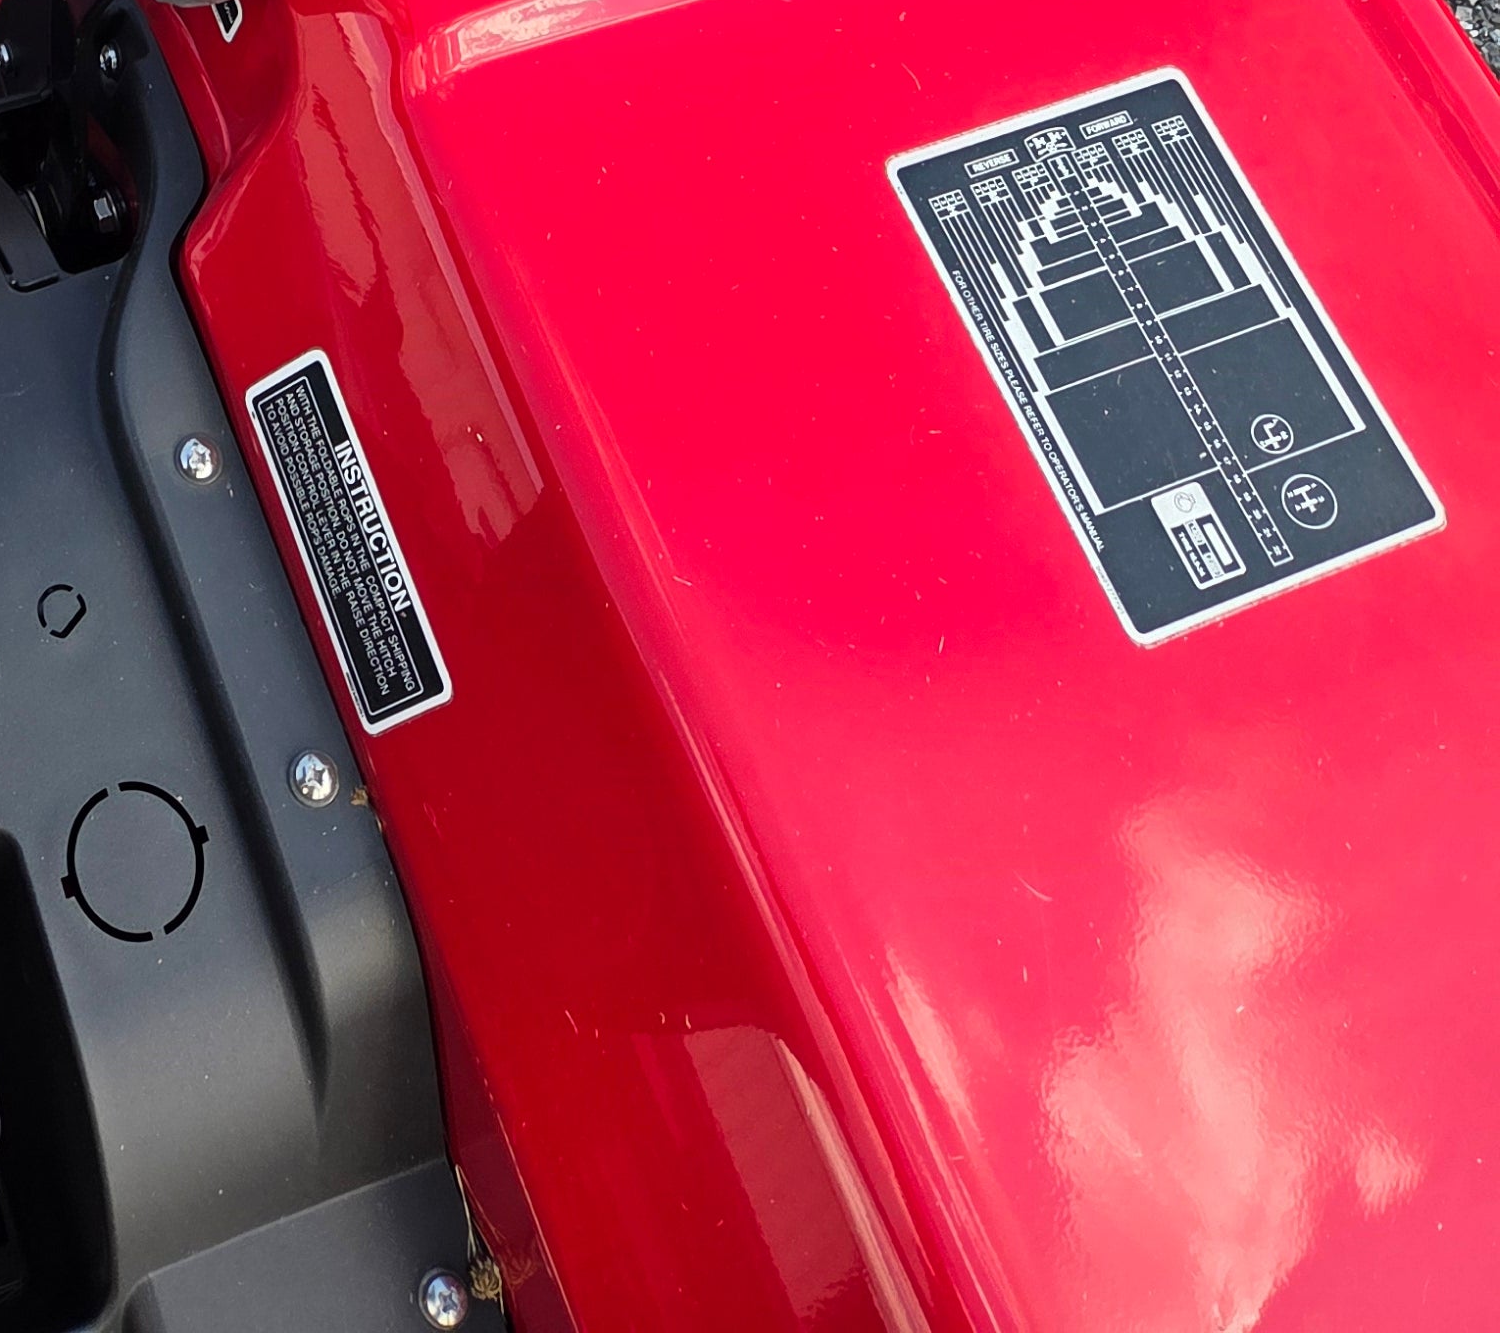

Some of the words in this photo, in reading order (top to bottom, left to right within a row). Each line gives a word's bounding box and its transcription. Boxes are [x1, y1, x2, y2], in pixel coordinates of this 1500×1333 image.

[1085, 114, 1128, 134] FORWARD
[972, 152, 1012, 172] REVERSE
[264, 403, 277, 422] TO
[284, 391, 300, 417] AND
[294, 384, 313, 416] WITH
[951, 267, 967, 290] FOR
[961, 287, 983, 321] OTHER
[978, 320, 995, 343] TIRE
[989, 340, 1009, 370] SIZES
[1003, 367, 1028, 405] PLEASE
[1022, 402, 1045, 437] REFER
[1040, 435, 1053, 453] TO
[1079, 509, 1105, 552] MANUAL
[270, 420, 290, 456] AVOID
[274, 397, 301, 452] POSITION
[305, 414, 322, 440] THE
[293, 415, 321, 472] STORAGE
[283, 455, 310, 512] POSSIBLE
[293, 451, 322, 509] CONTROL
[314, 438, 344, 498] FOLDABLE
[314, 471, 342, 530] POSITION,
[336, 497, 356, 533] ROPS
[303, 511, 322, 546] ROPS
[314, 508, 336, 549] LEVER
[333, 438, 411, 612] INSTRUCTION
[335, 529, 350, 551] DO
[348, 531, 362, 547] IN
[316, 545, 342, 599] DAMAGE.
[329, 549, 342, 564] IN
[342, 549, 359, 577] NOT
[353, 545, 371, 571] THE
[334, 563, 351, 590] THE
[352, 576, 373, 614] MOVE
[344, 589, 365, 628] RAISE
[364, 573, 394, 634] COMPACT
[366, 613, 383, 639] THE
[358, 627, 390, 696] DIRECTION
[375, 639, 397, 678] HITCH
[386, 633, 415, 692] SHIPPING
